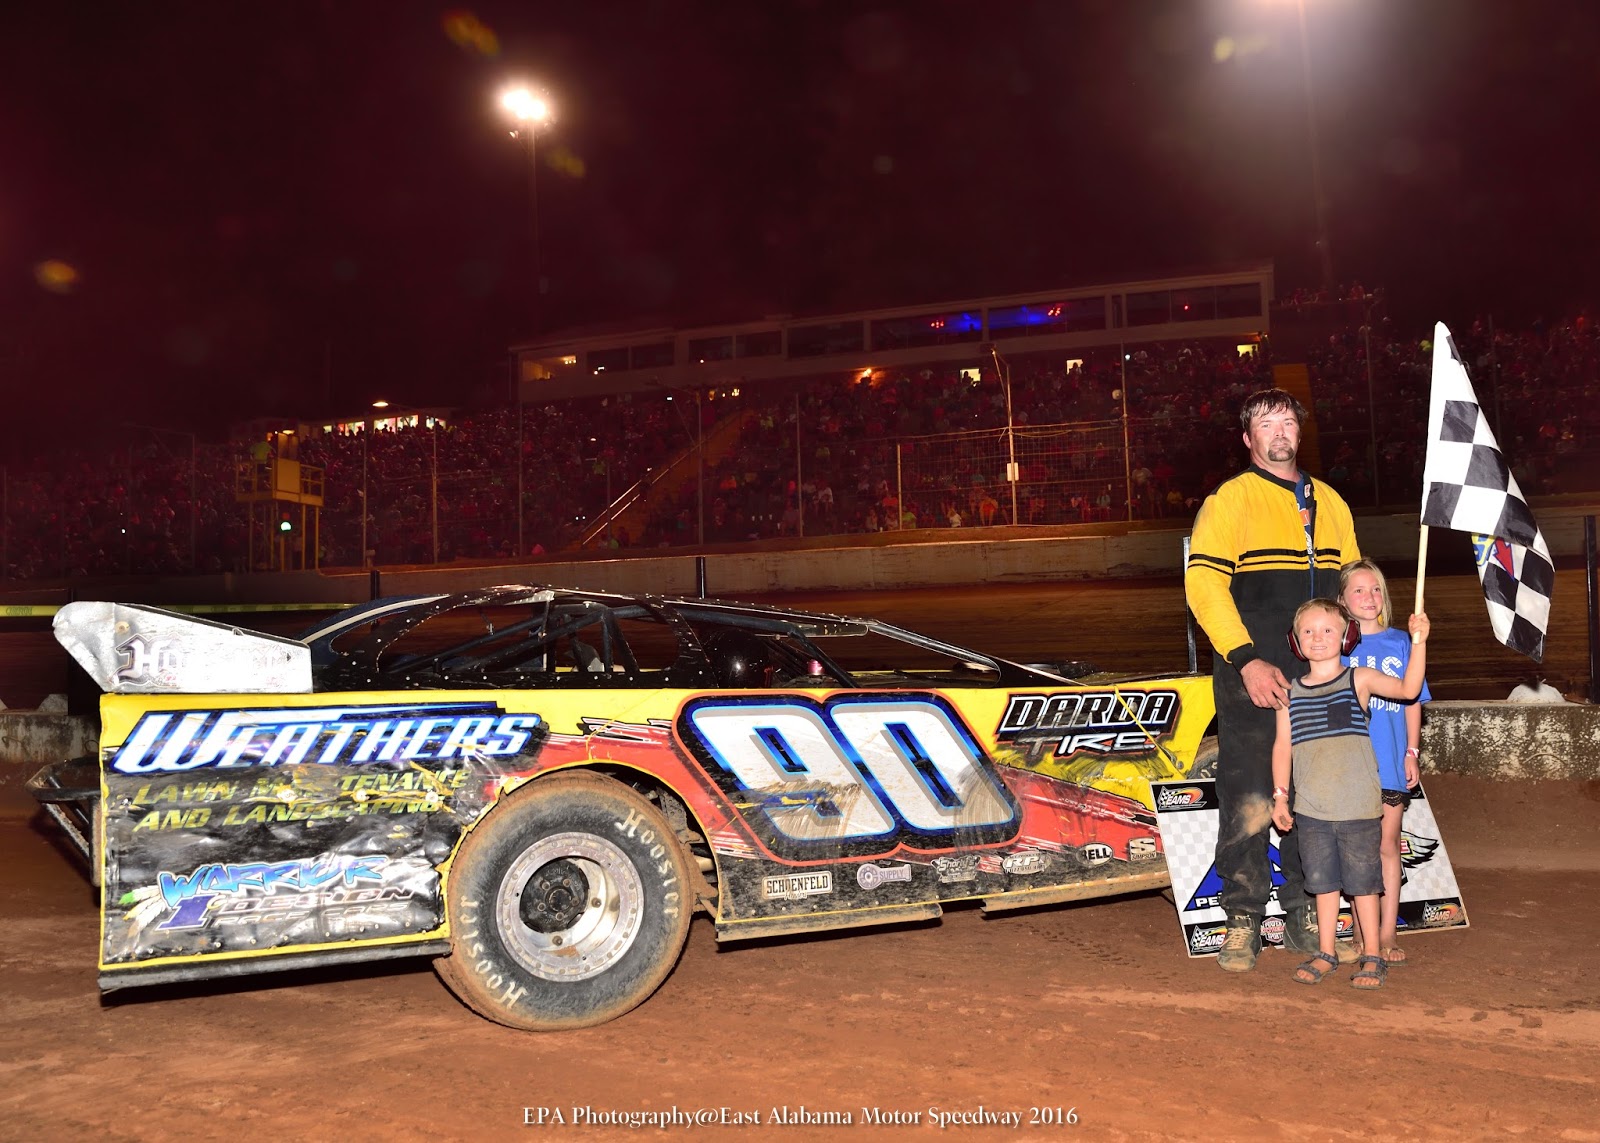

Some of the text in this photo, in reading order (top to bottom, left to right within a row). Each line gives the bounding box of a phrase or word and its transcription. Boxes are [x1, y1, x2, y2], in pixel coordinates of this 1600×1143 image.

[1000, 692, 1177, 732] DARDA
[108, 702, 542, 775] WEATHERS
[1017, 730, 1162, 757] TIRE
[688, 697, 1018, 844] 90
[132, 780, 240, 805] LAWN
[132, 807, 213, 832] AND
[766, 875, 829, 894] SCHOENFELD
[880, 870, 904, 880] SUPPLY
[1199, 933, 1226, 947] EAMS
